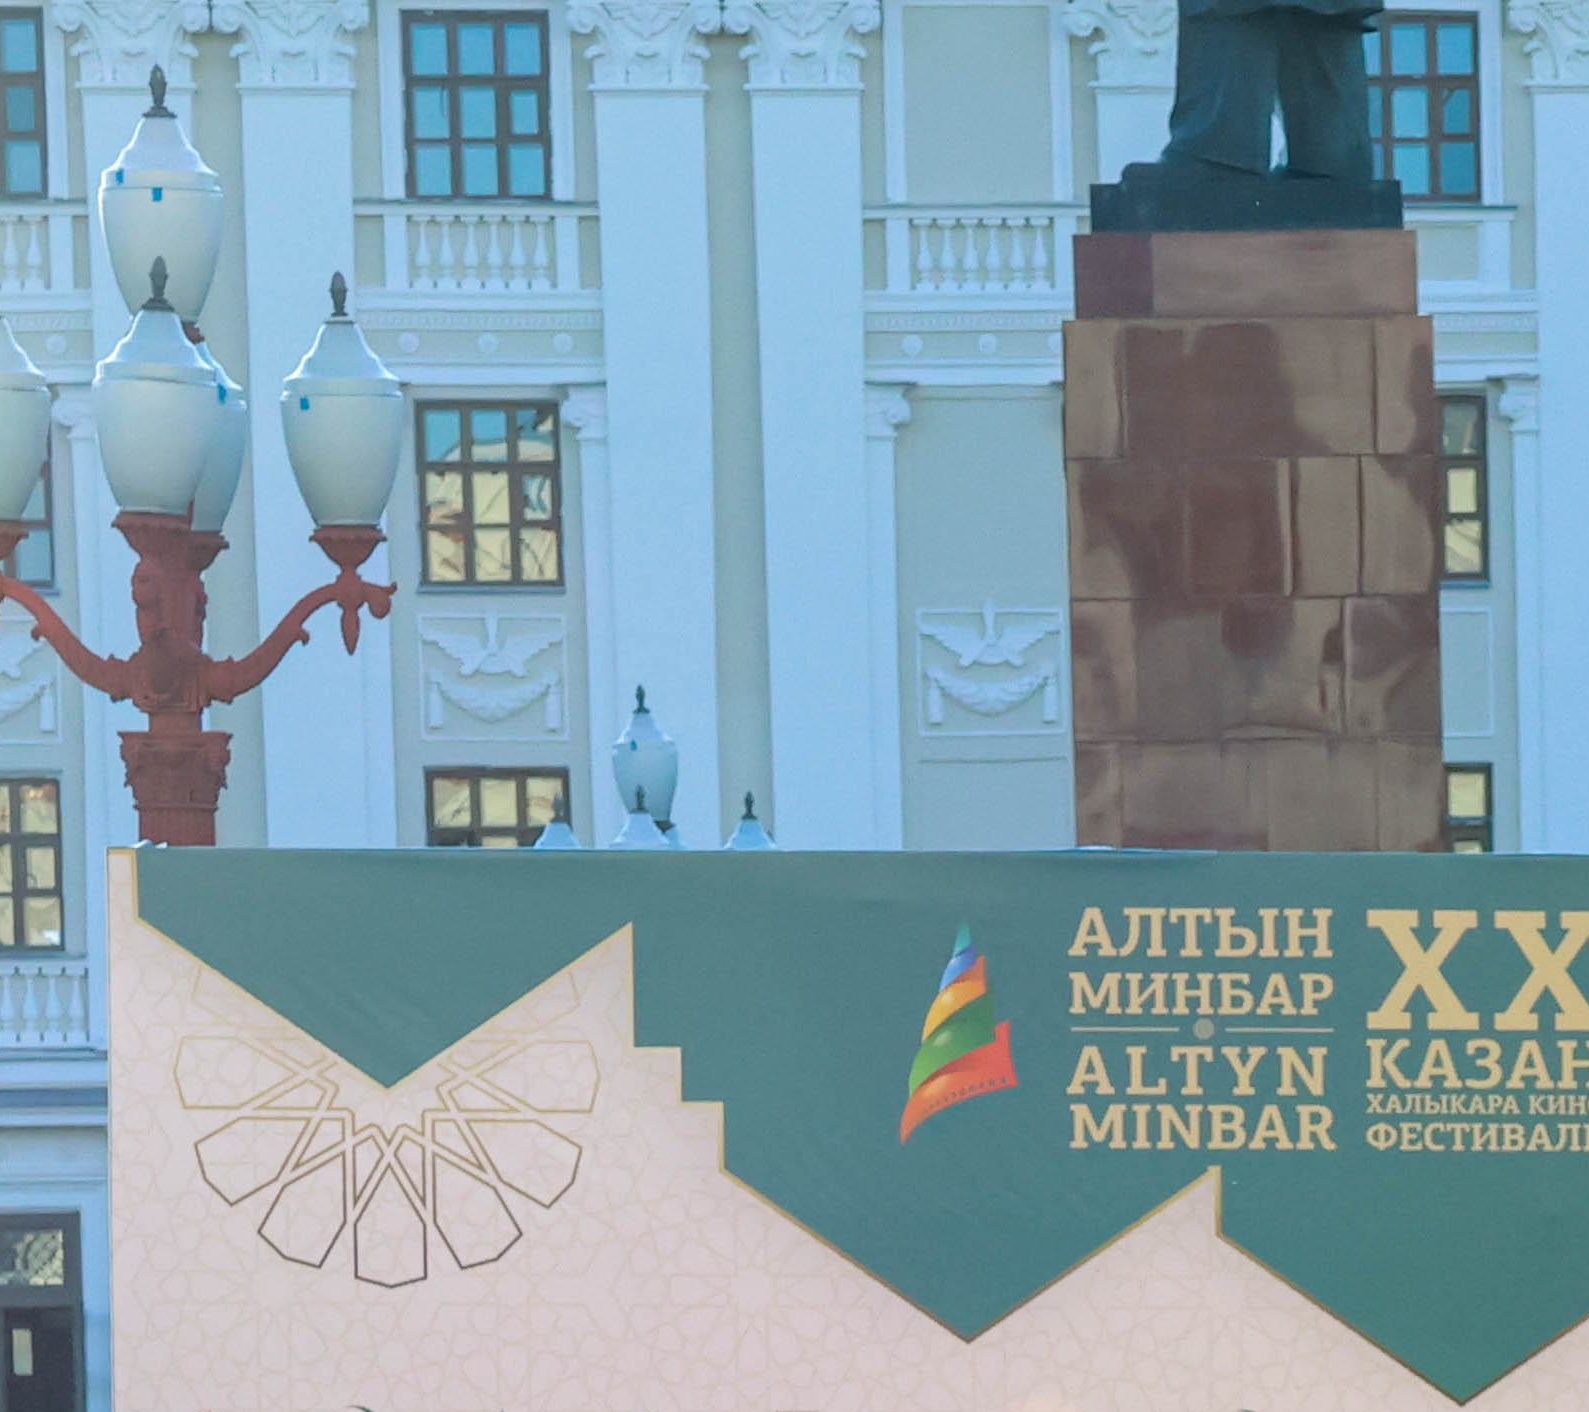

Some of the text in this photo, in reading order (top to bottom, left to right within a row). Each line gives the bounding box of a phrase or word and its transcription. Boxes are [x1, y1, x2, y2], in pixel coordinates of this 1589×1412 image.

[1068, 906, 1334, 958] АЛТЫН
[1068, 971, 1334, 1016] МИНБАР
[1067, 1045, 1327, 1096] ALTYN
[1068, 1103, 1337, 1150] MINBAR
[1365, 1093, 1520, 1116] ХАЛЫКАРА
